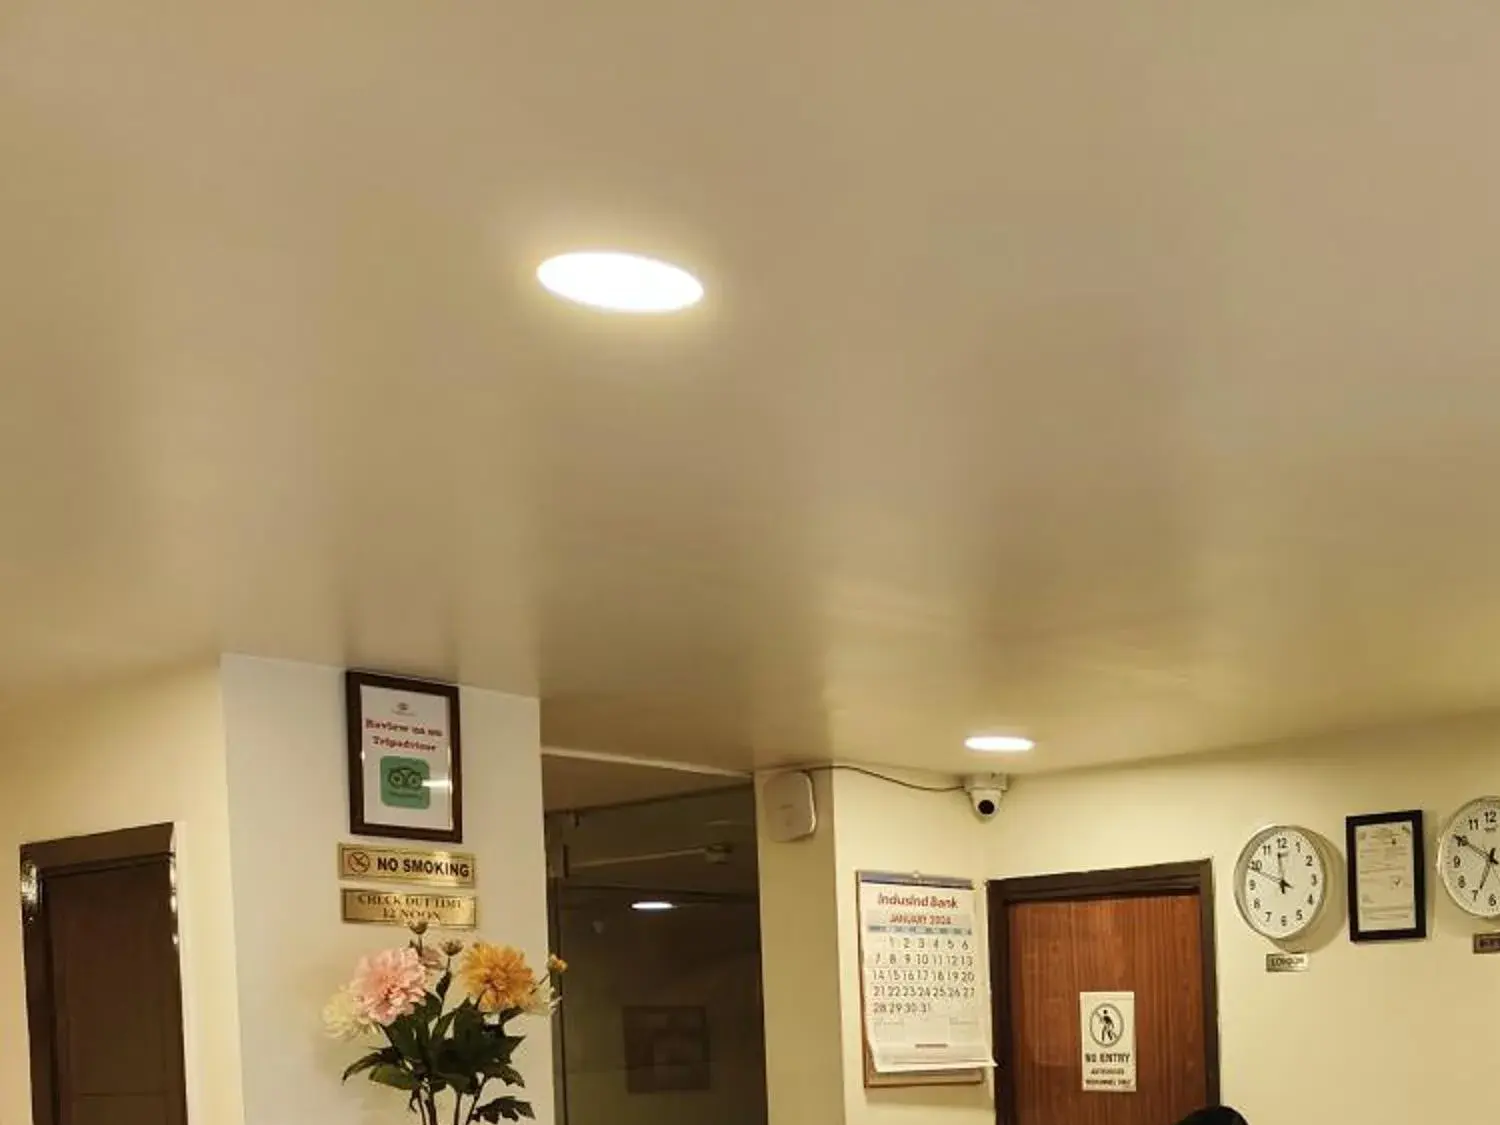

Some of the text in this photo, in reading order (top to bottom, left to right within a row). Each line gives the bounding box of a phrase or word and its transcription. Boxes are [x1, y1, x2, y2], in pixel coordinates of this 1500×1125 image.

[1484, 812, 1496, 823] 12
[1469, 819, 1478, 830] 11
[1277, 838, 1287, 848] 12
[1296, 842, 1301, 853] 1
[1263, 846, 1271, 855] 11
[1306, 855, 1312, 866] 2
[1454, 856, 1461, 868] 9
[377, 857, 470, 878] NO SMOKING
[1249, 880, 1256, 890] 9
[1311, 874, 1317, 886] 3
[1458, 876, 1465, 888] 8
[358, 894, 401, 905] CHECK
[1308, 894, 1313, 905] 4
[1472, 890, 1478, 901] 7
[1489, 894, 1496, 906] 6
[930, 896, 958, 908] Bank
[1254, 899, 1260, 908] 8
[401, 909, 441, 921] NOON
[1265, 912, 1272, 922] 7
[1296, 910, 1302, 920] 5
[1281, 916, 1287, 926] 6
[1100, 1053, 1131, 1063] ENTRY
